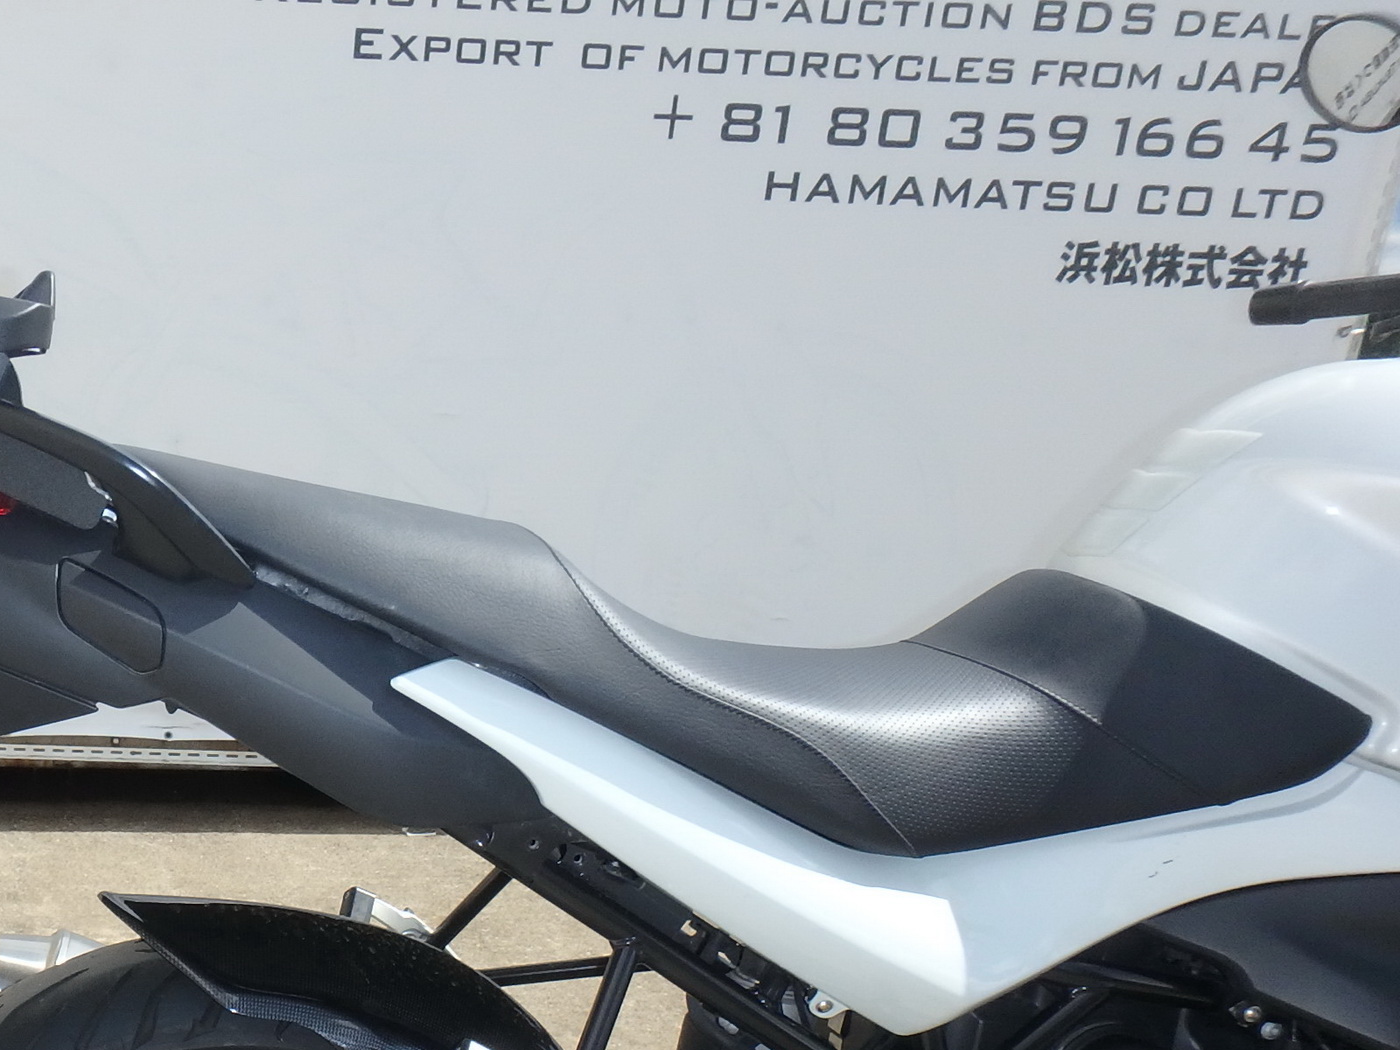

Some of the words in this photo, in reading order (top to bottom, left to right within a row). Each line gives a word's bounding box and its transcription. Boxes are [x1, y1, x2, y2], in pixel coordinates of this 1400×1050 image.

[1032, 0, 1156, 36] BDS
[1174, 10, 1337, 41] DEALE
[352, 27, 554, 68] EXPORT
[580, 42, 645, 71] OF
[657, 46, 1015, 85] MOTORCYCLES
[1031, 59, 1163, 90] FROM
[720, 102, 791, 144] 81
[826, 106, 922, 149] 80
[944, 110, 1089, 155] 359
[1114, 116, 1225, 160] 166
[1248, 121, 1338, 164] 45
[764, 170, 1119, 214] HAMAMATSU
[1136, 184, 1214, 217] CO
[1230, 187, 1325, 221] LTD
[1055, 240, 1309, 290] 浜松株式会社
